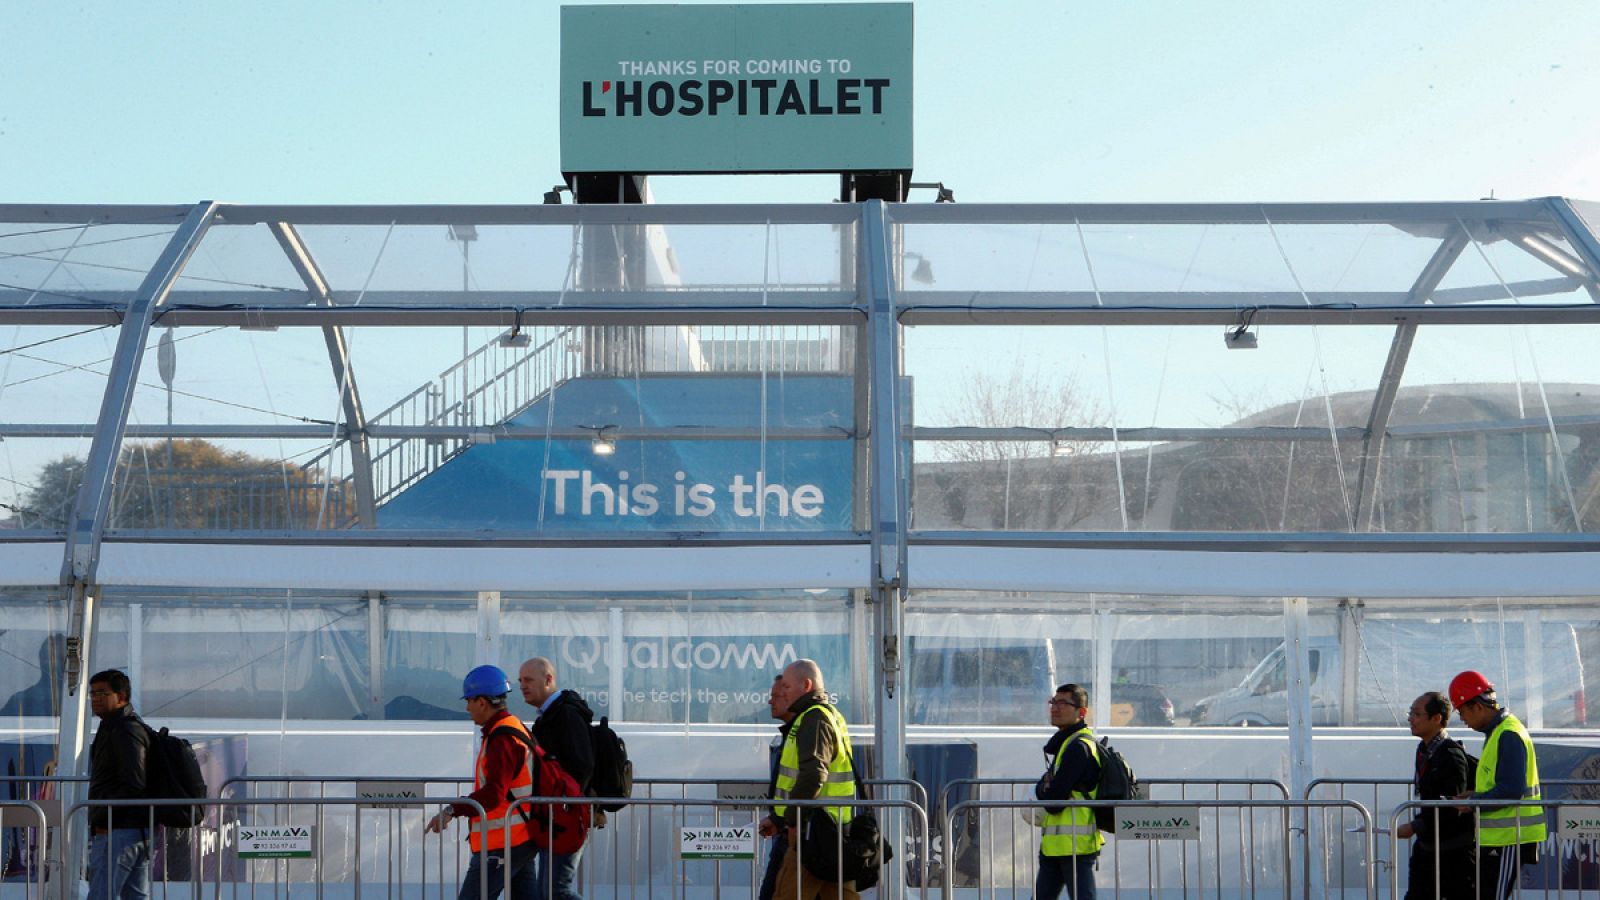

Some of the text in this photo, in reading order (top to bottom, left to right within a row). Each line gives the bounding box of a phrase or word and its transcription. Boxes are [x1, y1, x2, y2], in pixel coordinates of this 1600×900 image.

[618, 59, 851, 76] THANKS FOR COMING TO
[582, 79, 890, 117] L'HOSPITALET
[541, 470, 825, 518] This is the
[561, 634, 798, 674] Qualcomm
[623, 687, 645, 704] he
[649, 687, 692, 704] tech
[697, 688, 728, 704] the
[1136, 817, 1190, 828] INMAVA
[255, 827, 309, 837] INMAVA
[698, 828, 751, 838] INMAVA
